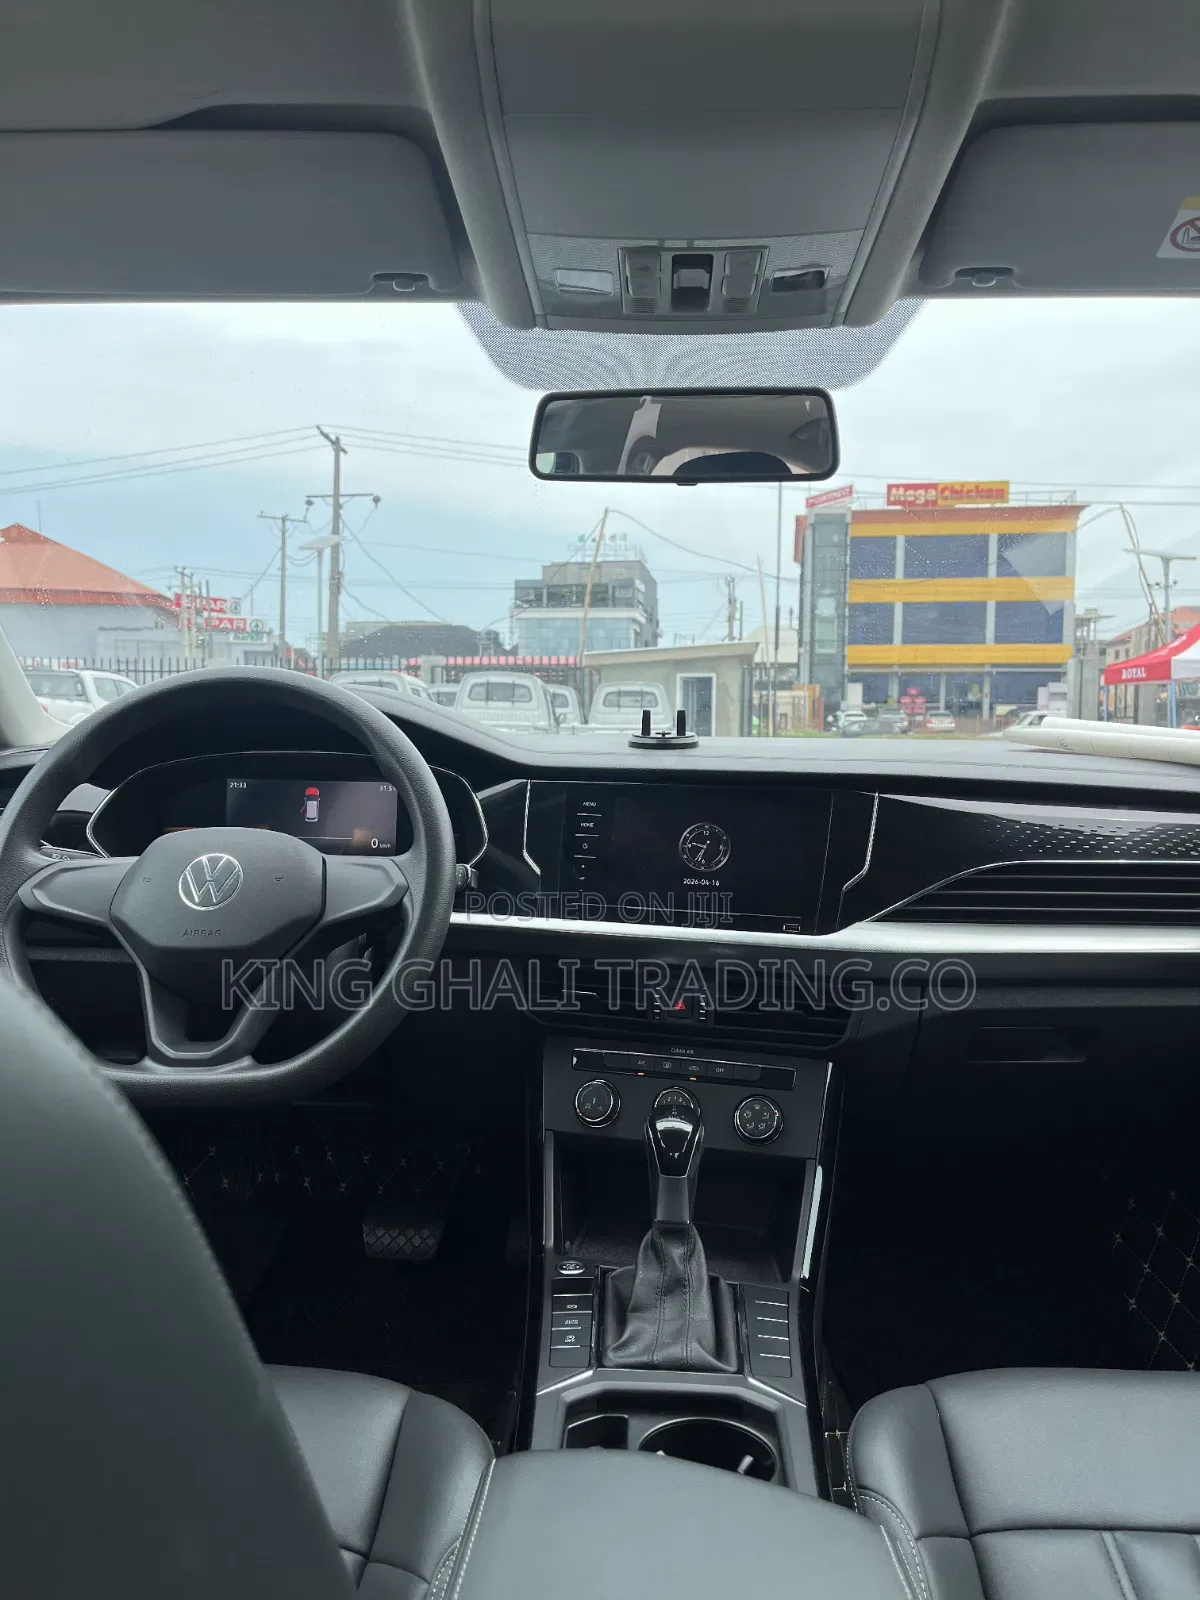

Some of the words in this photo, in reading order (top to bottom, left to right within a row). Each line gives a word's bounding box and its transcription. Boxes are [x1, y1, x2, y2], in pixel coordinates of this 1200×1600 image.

[889, 486, 937, 505] Mega
[939, 483, 1006, 502] Chicken
[1121, 666, 1147, 680] ROYAL
[371, 837, 379, 849] 0
[182, 929, 222, 938] AIRBAG
